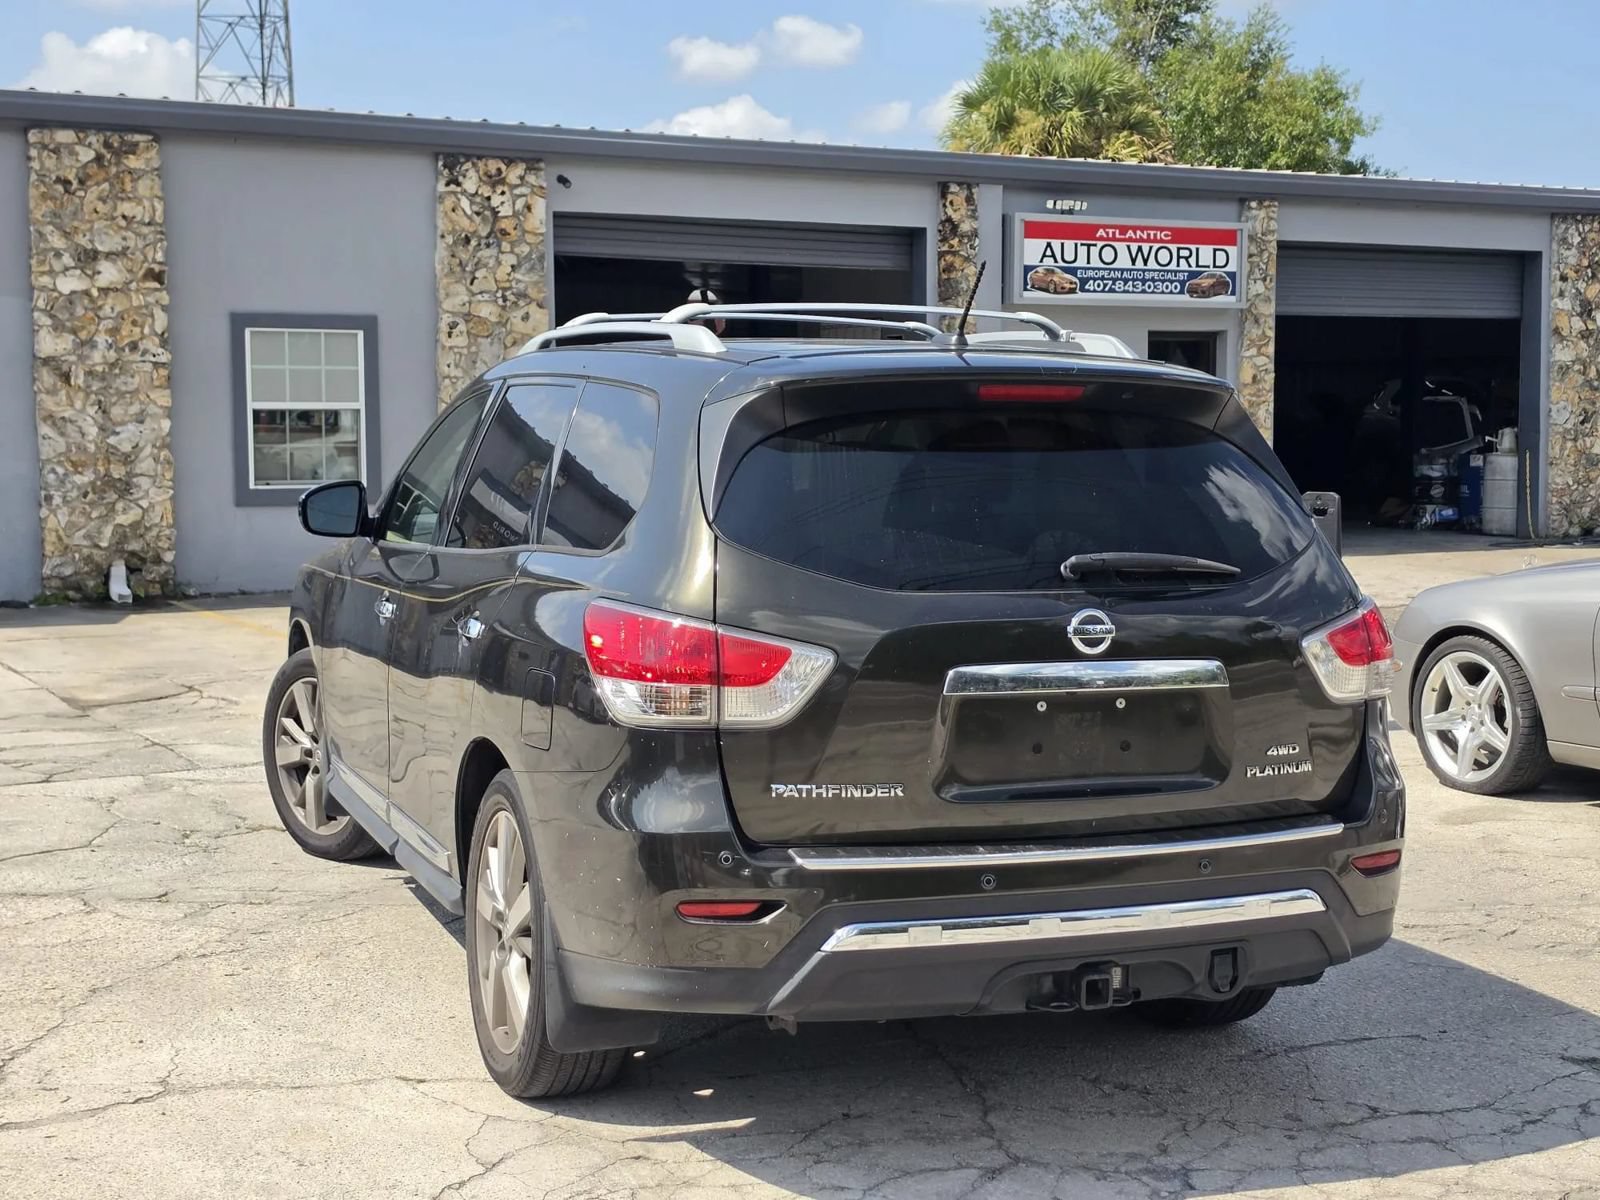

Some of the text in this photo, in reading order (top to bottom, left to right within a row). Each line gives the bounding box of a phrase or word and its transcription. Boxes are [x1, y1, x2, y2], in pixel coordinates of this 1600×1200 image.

[1095, 228, 1172, 240] ATLANTIC
[1039, 241, 1230, 269] AUTO WORLD
[1077, 269, 1189, 281] EUROPEAN AUTO SPECIALIST
[1085, 280, 1181, 293] 407-843-0300
[1072, 626, 1113, 635] NISSAN
[1266, 743, 1300, 756] 4WD
[1245, 760, 1313, 778] PLATINUM
[770, 783, 905, 798] PATHFINDER
